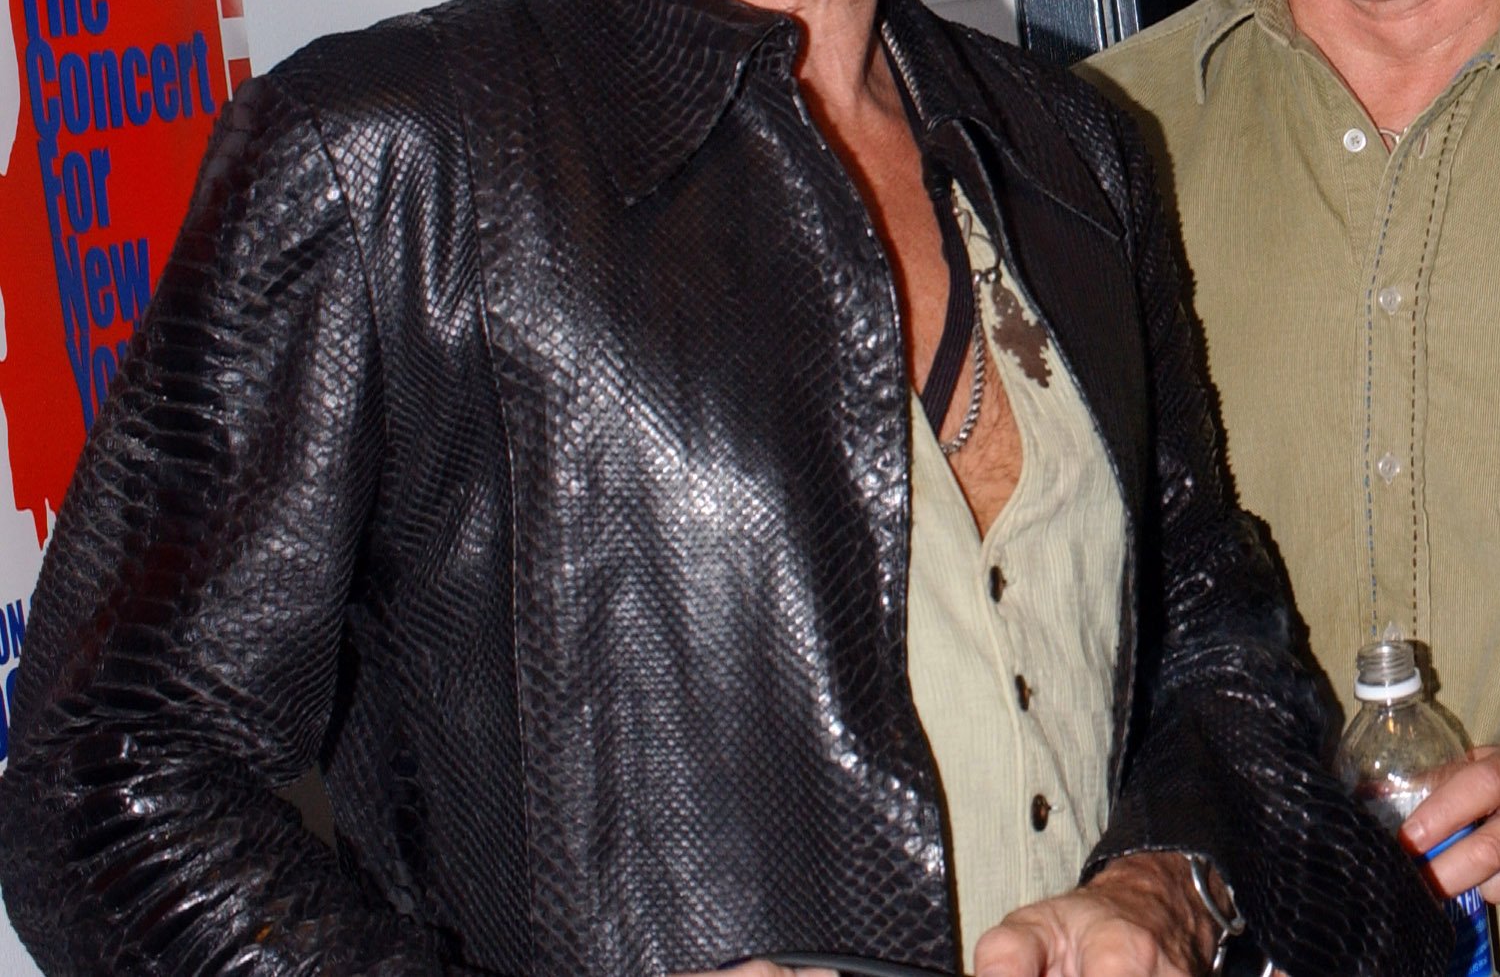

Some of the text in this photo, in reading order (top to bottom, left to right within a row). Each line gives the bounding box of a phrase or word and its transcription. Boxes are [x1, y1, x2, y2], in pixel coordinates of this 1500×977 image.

[26, 30, 216, 140] Concert
[37, 138, 111, 238] For
[53, 235, 151, 338] New
[65, 319, 141, 434] Yo
